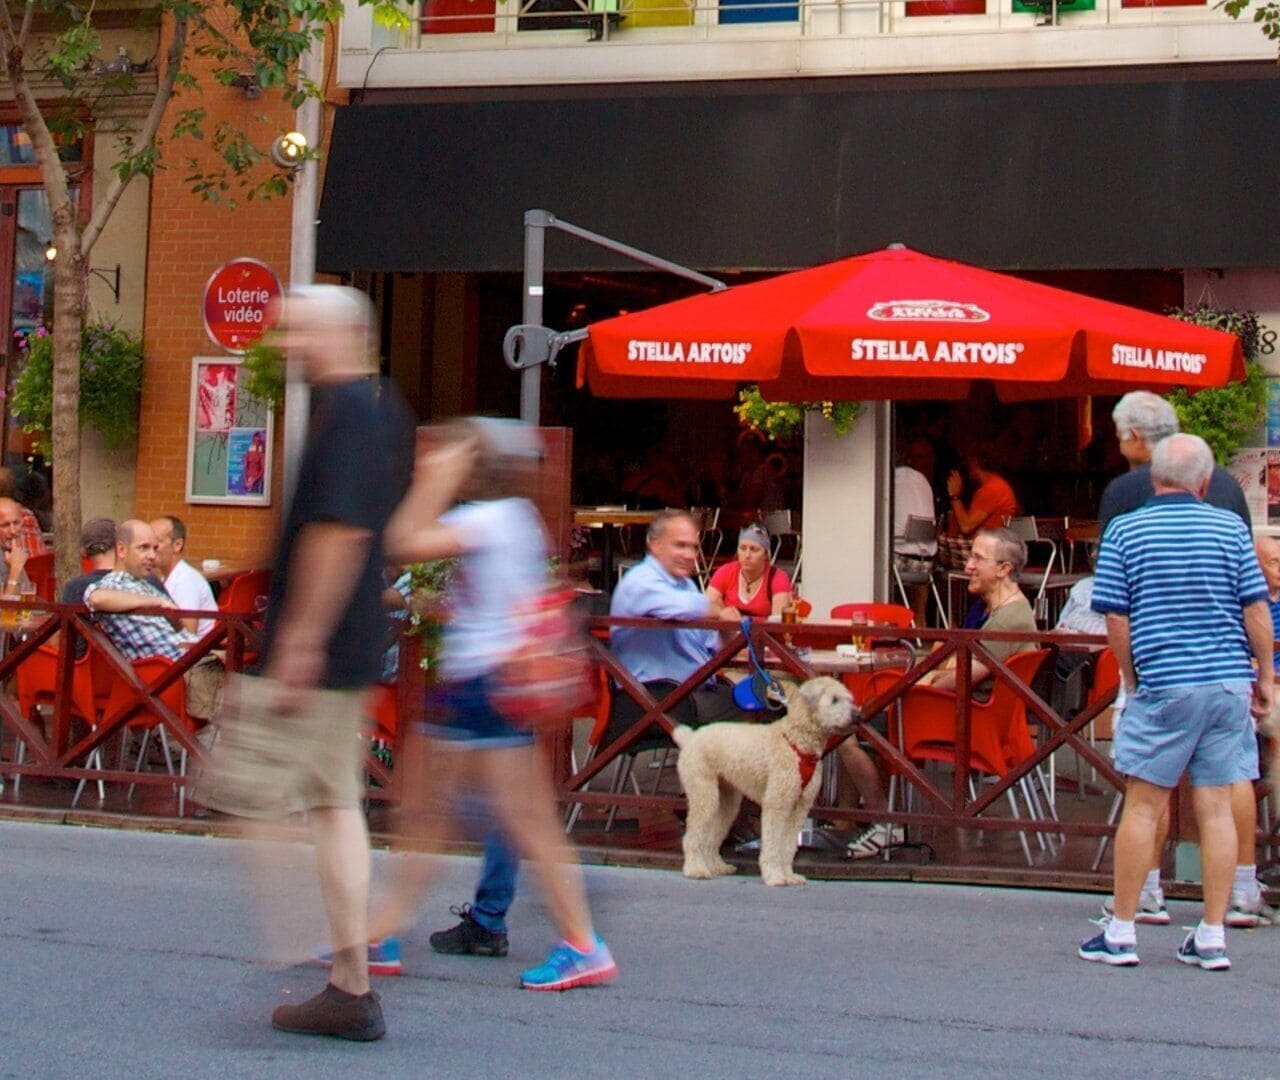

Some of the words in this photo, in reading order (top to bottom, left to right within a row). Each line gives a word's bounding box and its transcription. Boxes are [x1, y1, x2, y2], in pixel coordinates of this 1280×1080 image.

[218, 286, 270, 304] Loterie
[224, 306, 263, 323] vidéo
[627, 339, 685, 362] STELLA
[851, 338, 930, 362] STELLA
[1112, 343, 1154, 369] STELLA
